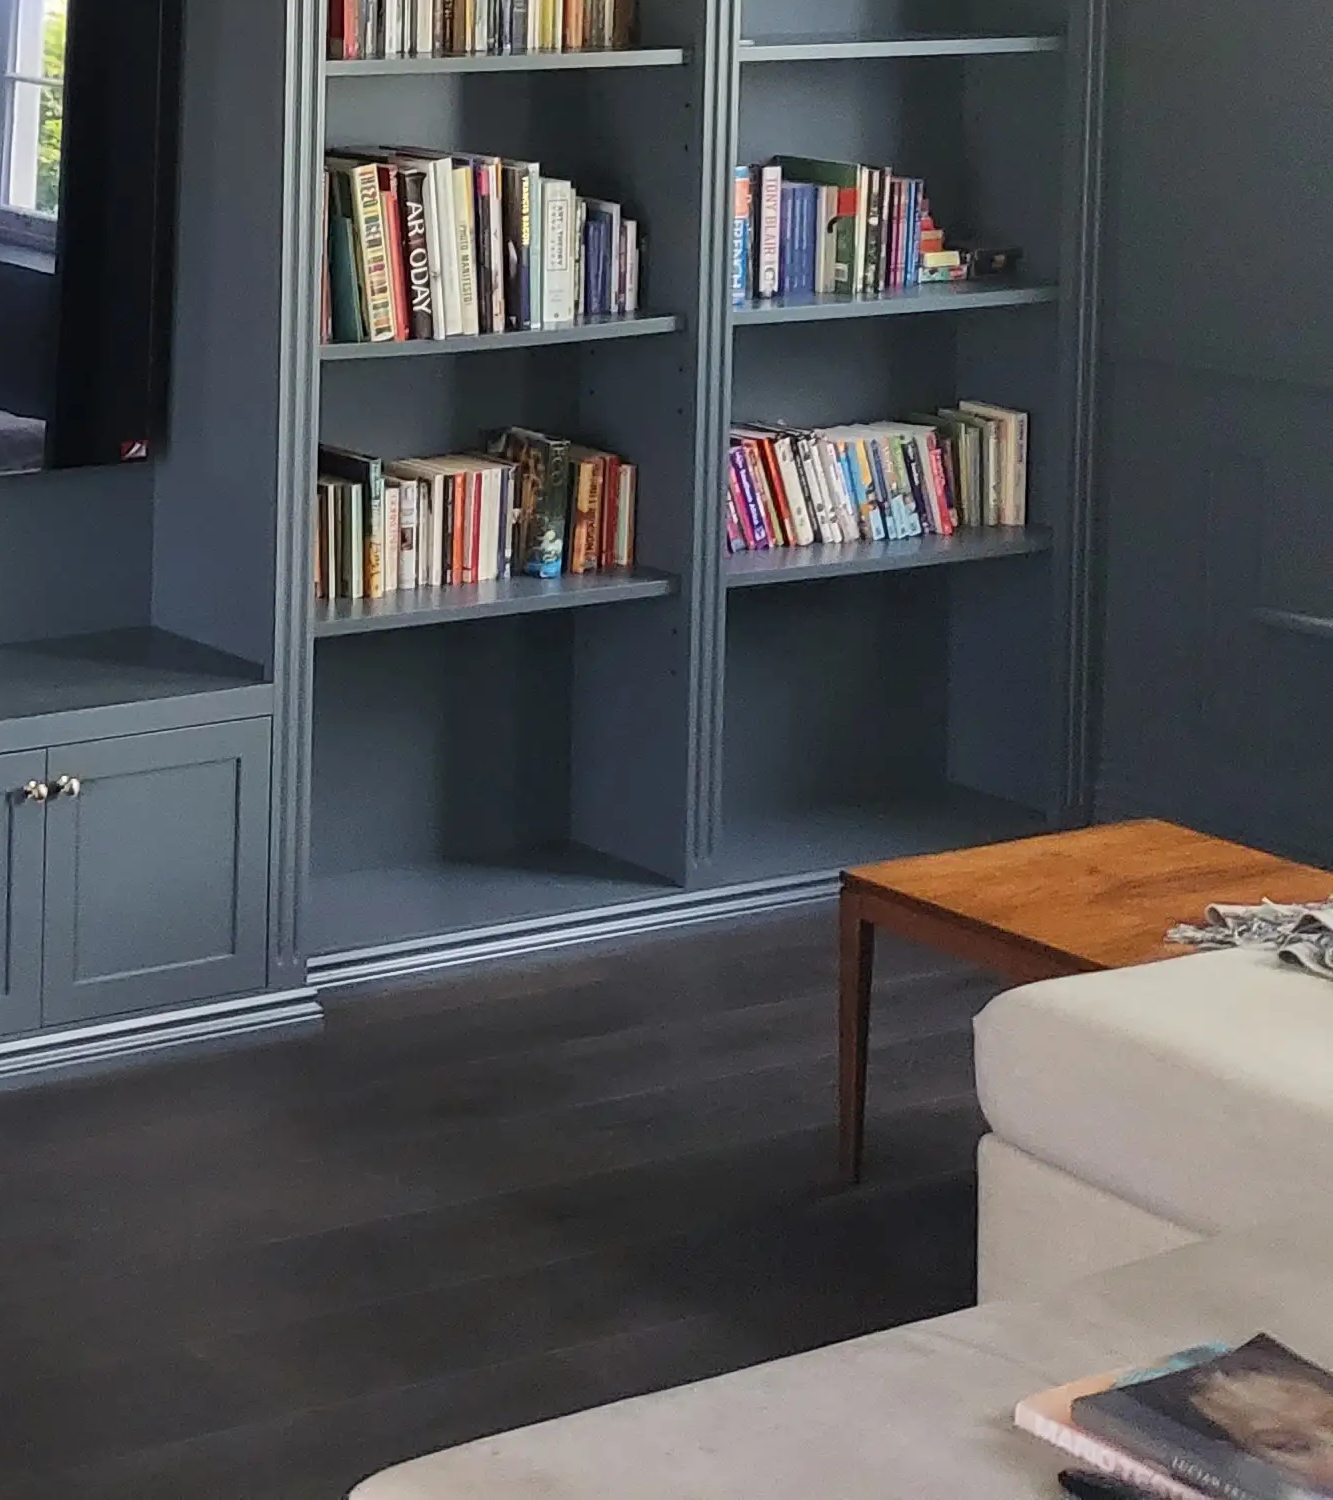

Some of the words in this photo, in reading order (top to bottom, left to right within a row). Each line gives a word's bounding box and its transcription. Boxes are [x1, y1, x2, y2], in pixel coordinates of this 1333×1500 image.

[521, 176, 529, 214] FRANCIS
[765, 178, 777, 211] TONY
[521, 215, 529, 245] BACON
[763, 216, 777, 255] BLAIR
